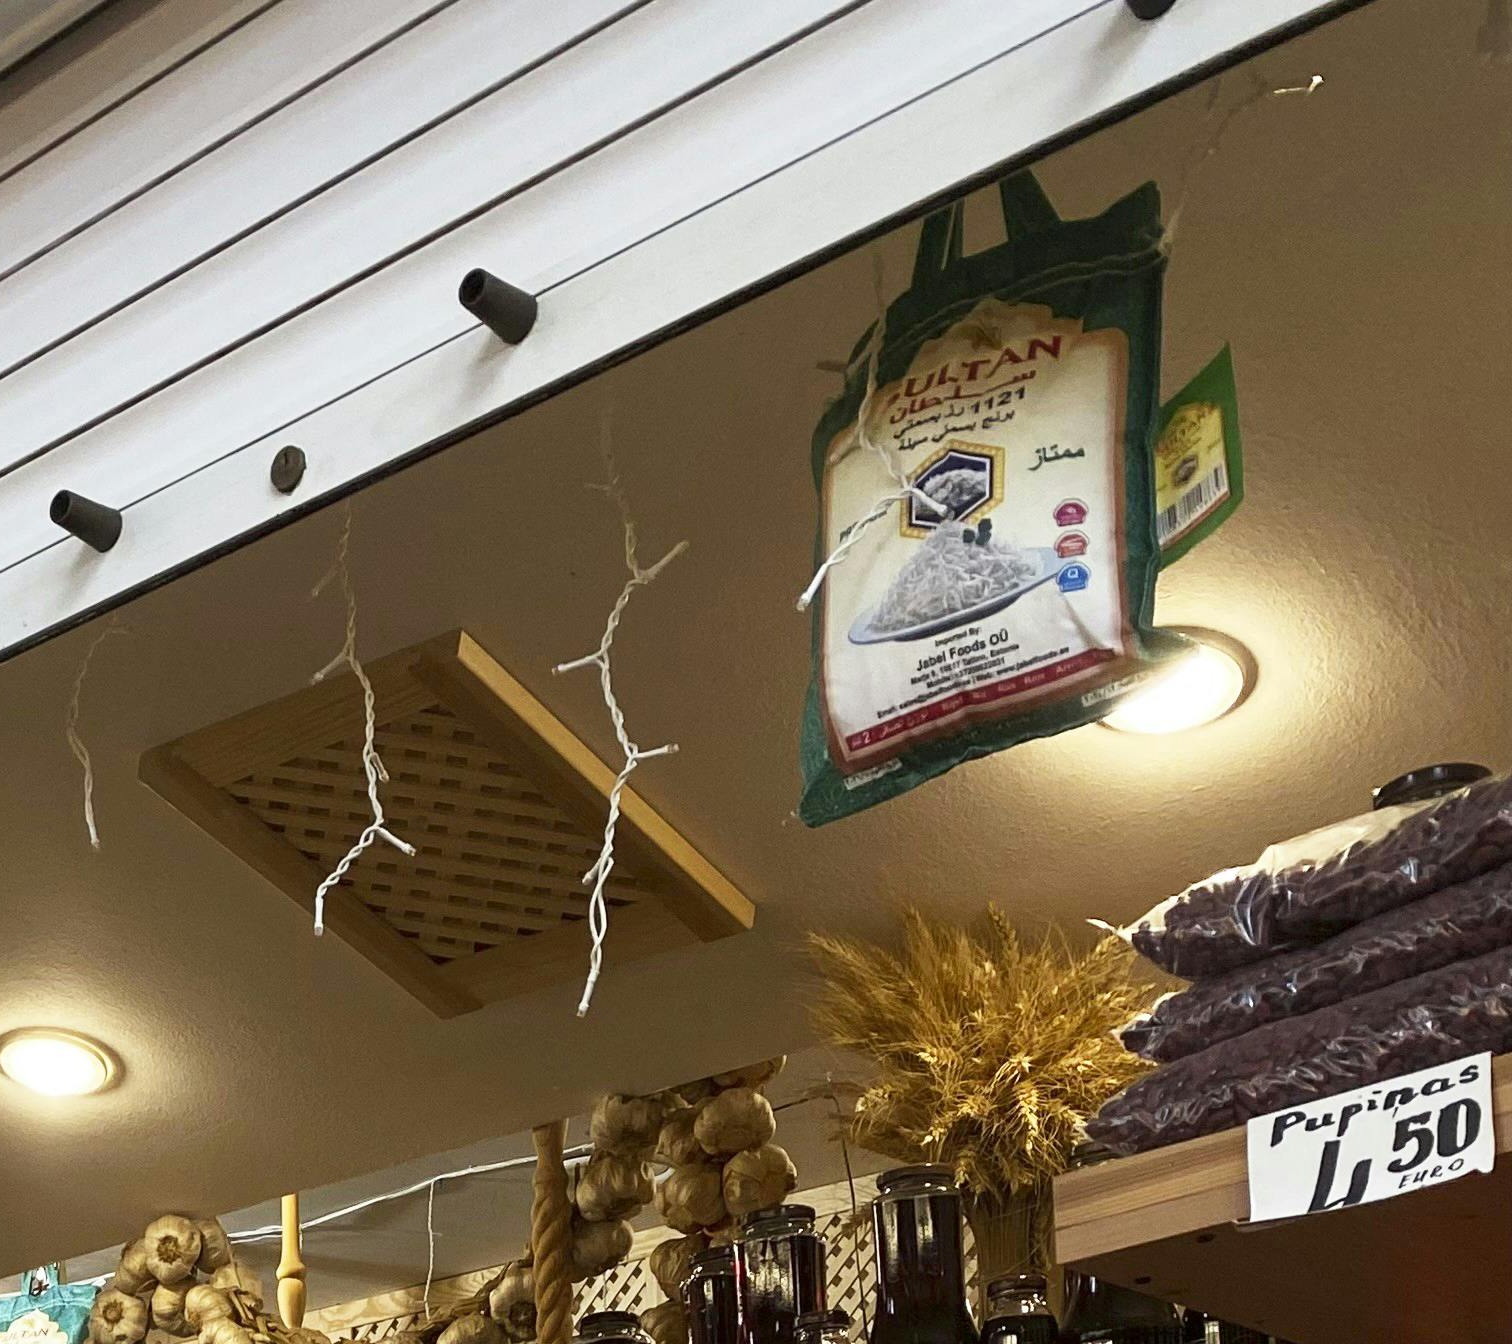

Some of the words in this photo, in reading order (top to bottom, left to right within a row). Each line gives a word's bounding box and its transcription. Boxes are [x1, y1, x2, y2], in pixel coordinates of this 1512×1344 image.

[971, 386, 1026, 414] 1121
[916, 648, 947, 672] Jabel
[949, 638, 987, 661] Foods
[1387, 1097, 1482, 1173] 50
[1398, 1157, 1465, 1190] EURO
